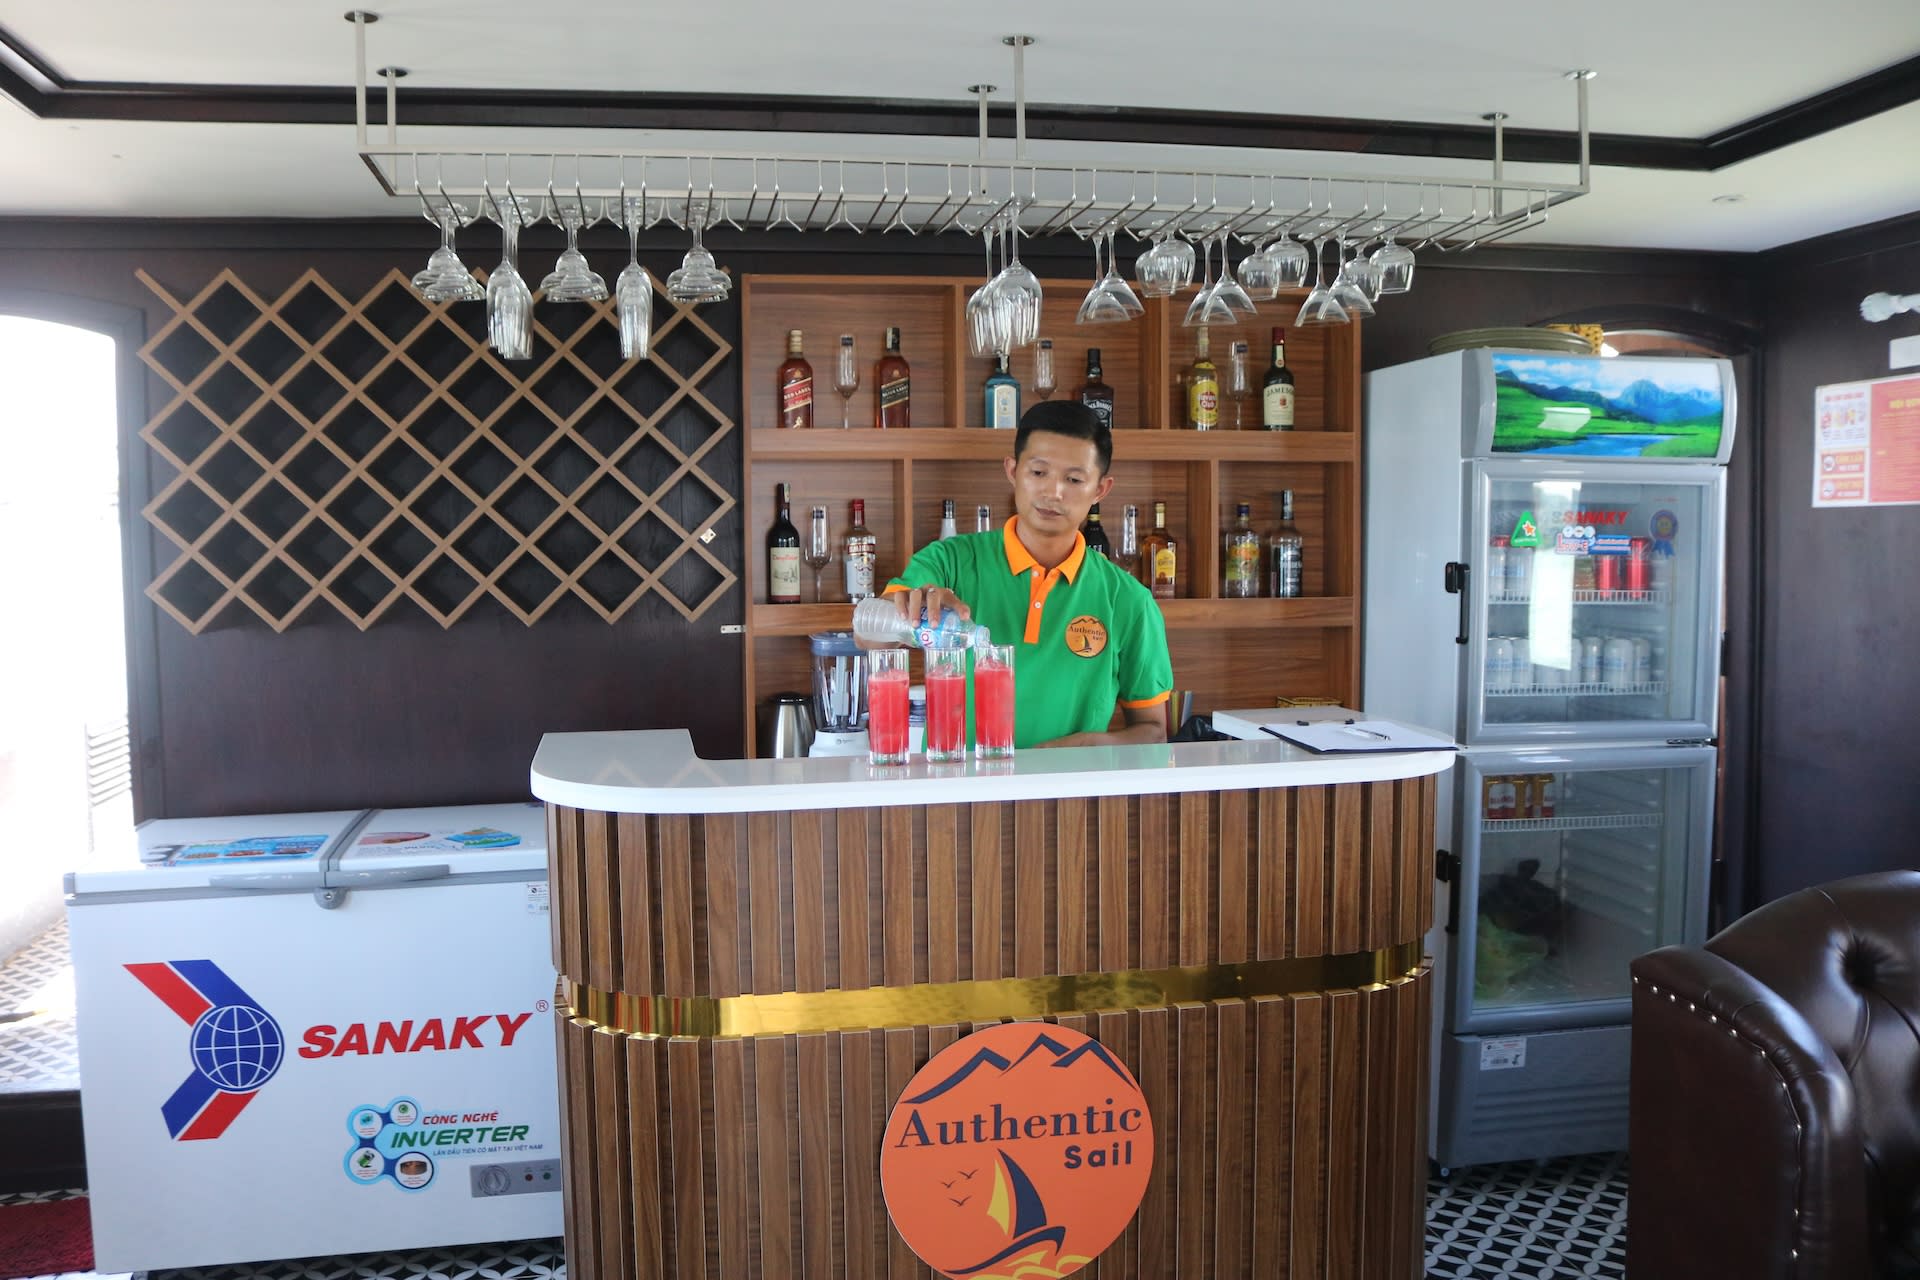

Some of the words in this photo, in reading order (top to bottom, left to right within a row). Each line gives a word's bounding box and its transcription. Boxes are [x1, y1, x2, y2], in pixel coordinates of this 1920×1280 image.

[1070, 626, 1105, 636] Authentic
[298, 1013, 533, 1059] SANAKY
[390, 1125, 530, 1149] INVERTER
[894, 1098, 1142, 1148] Authentic
[1064, 1141, 1132, 1169] Sail
